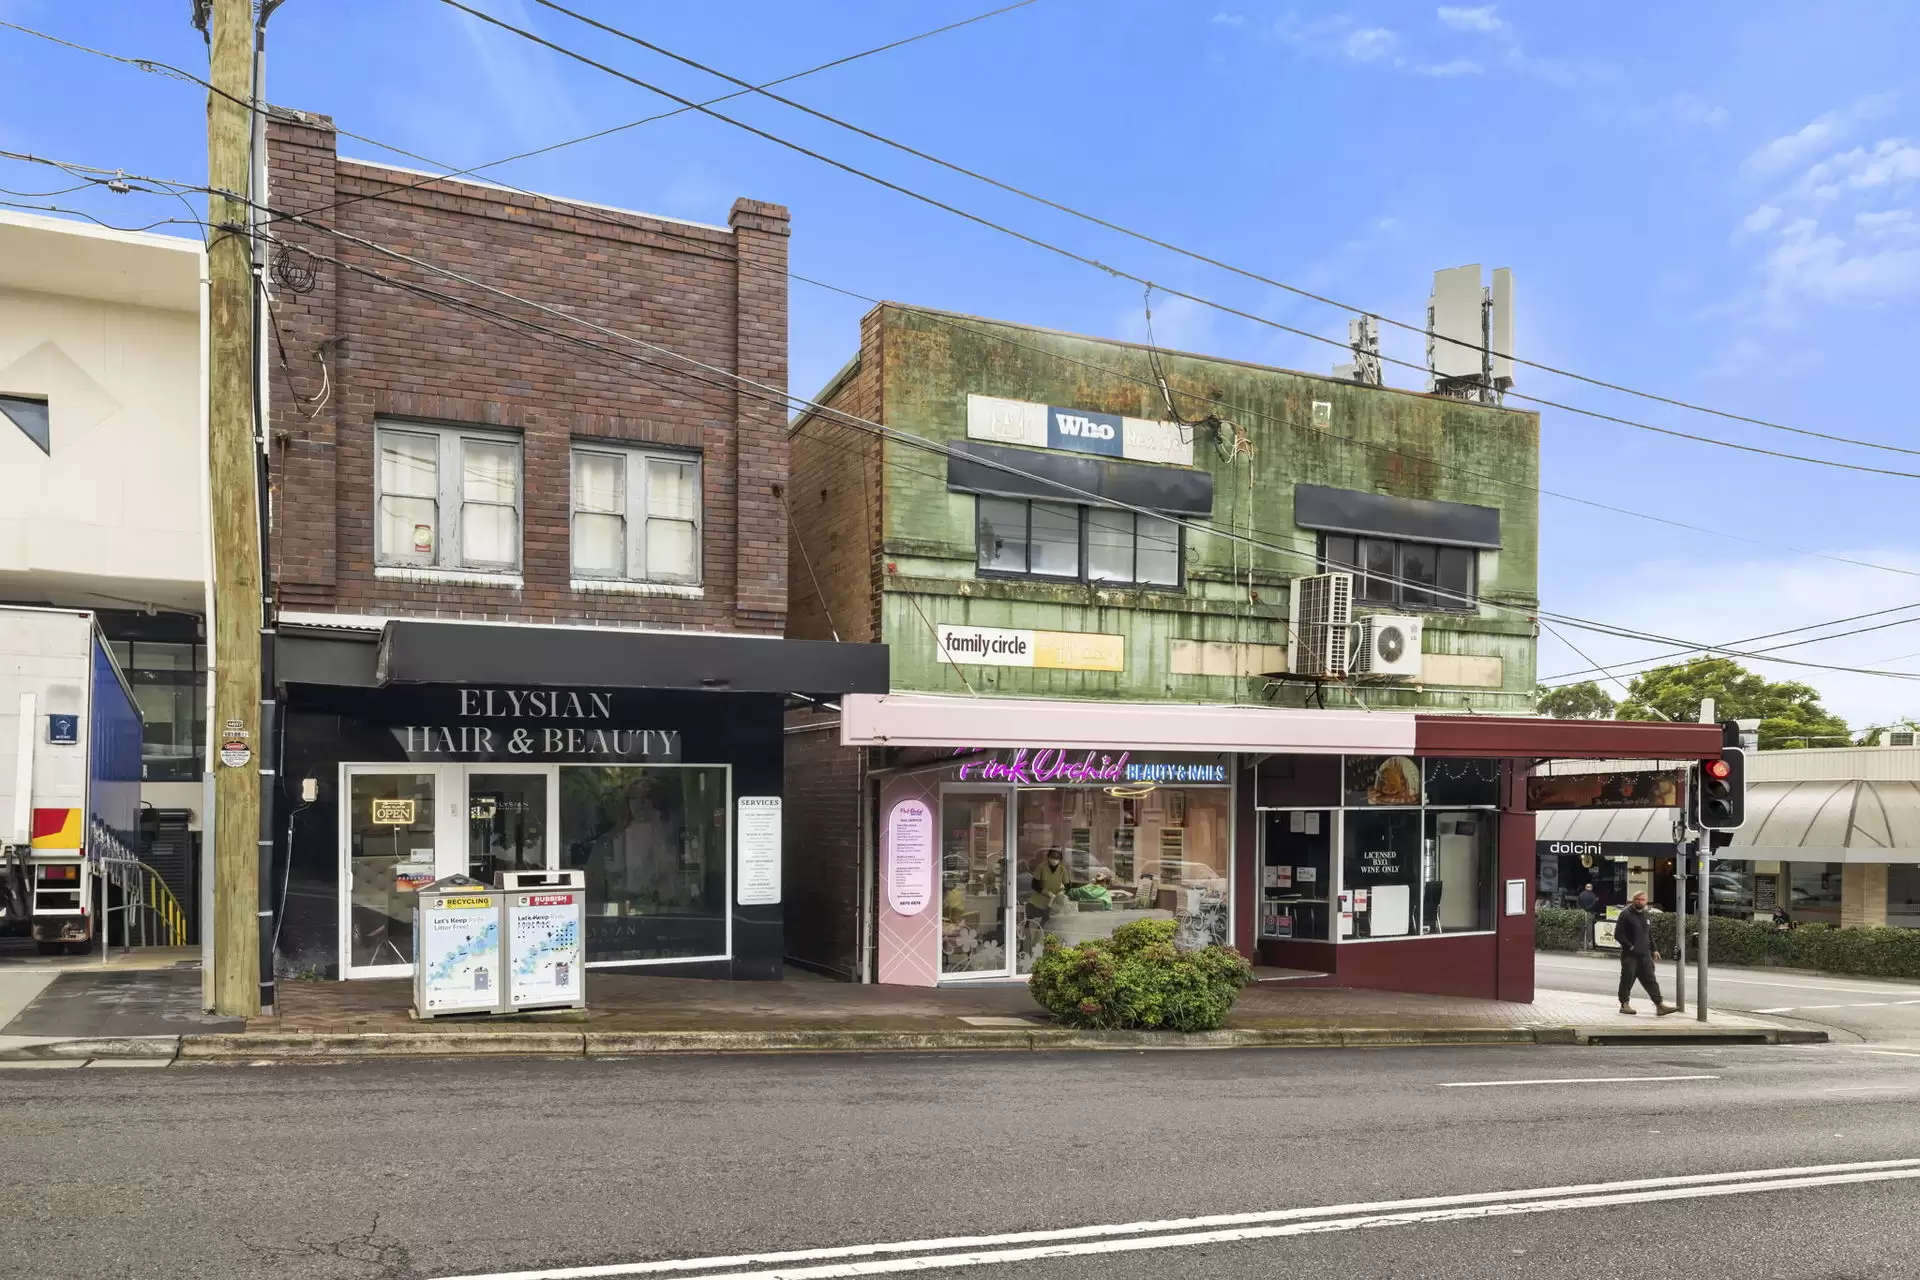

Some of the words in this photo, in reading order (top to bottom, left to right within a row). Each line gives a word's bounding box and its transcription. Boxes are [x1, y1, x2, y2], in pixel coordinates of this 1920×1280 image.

[1056, 413, 1115, 440] Who
[945, 632, 990, 657] family
[991, 635, 1027, 655] circle
[458, 689, 612, 720] ELYSIAN
[404, 726, 495, 753] HAIR
[507, 727, 534, 755] &
[542, 728, 681, 755] BEAUTY
[1031, 748, 1131, 782] Orchid
[1126, 763, 1176, 781] BEAUTY
[1176, 764, 1187, 781] &
[1187, 764, 1225, 781] NAILS
[377, 808, 410, 818] OPEN
[1550, 842, 1602, 855] dolcini
[1364, 851, 1397, 859] LICENSED
[1360, 865, 1380, 873] WINE
[1381, 865, 1400, 873] ONLY
[447, 897, 489, 905] RECYCLING
[534, 895, 567, 903] RUBBISH
[434, 917, 450, 925] Let's
